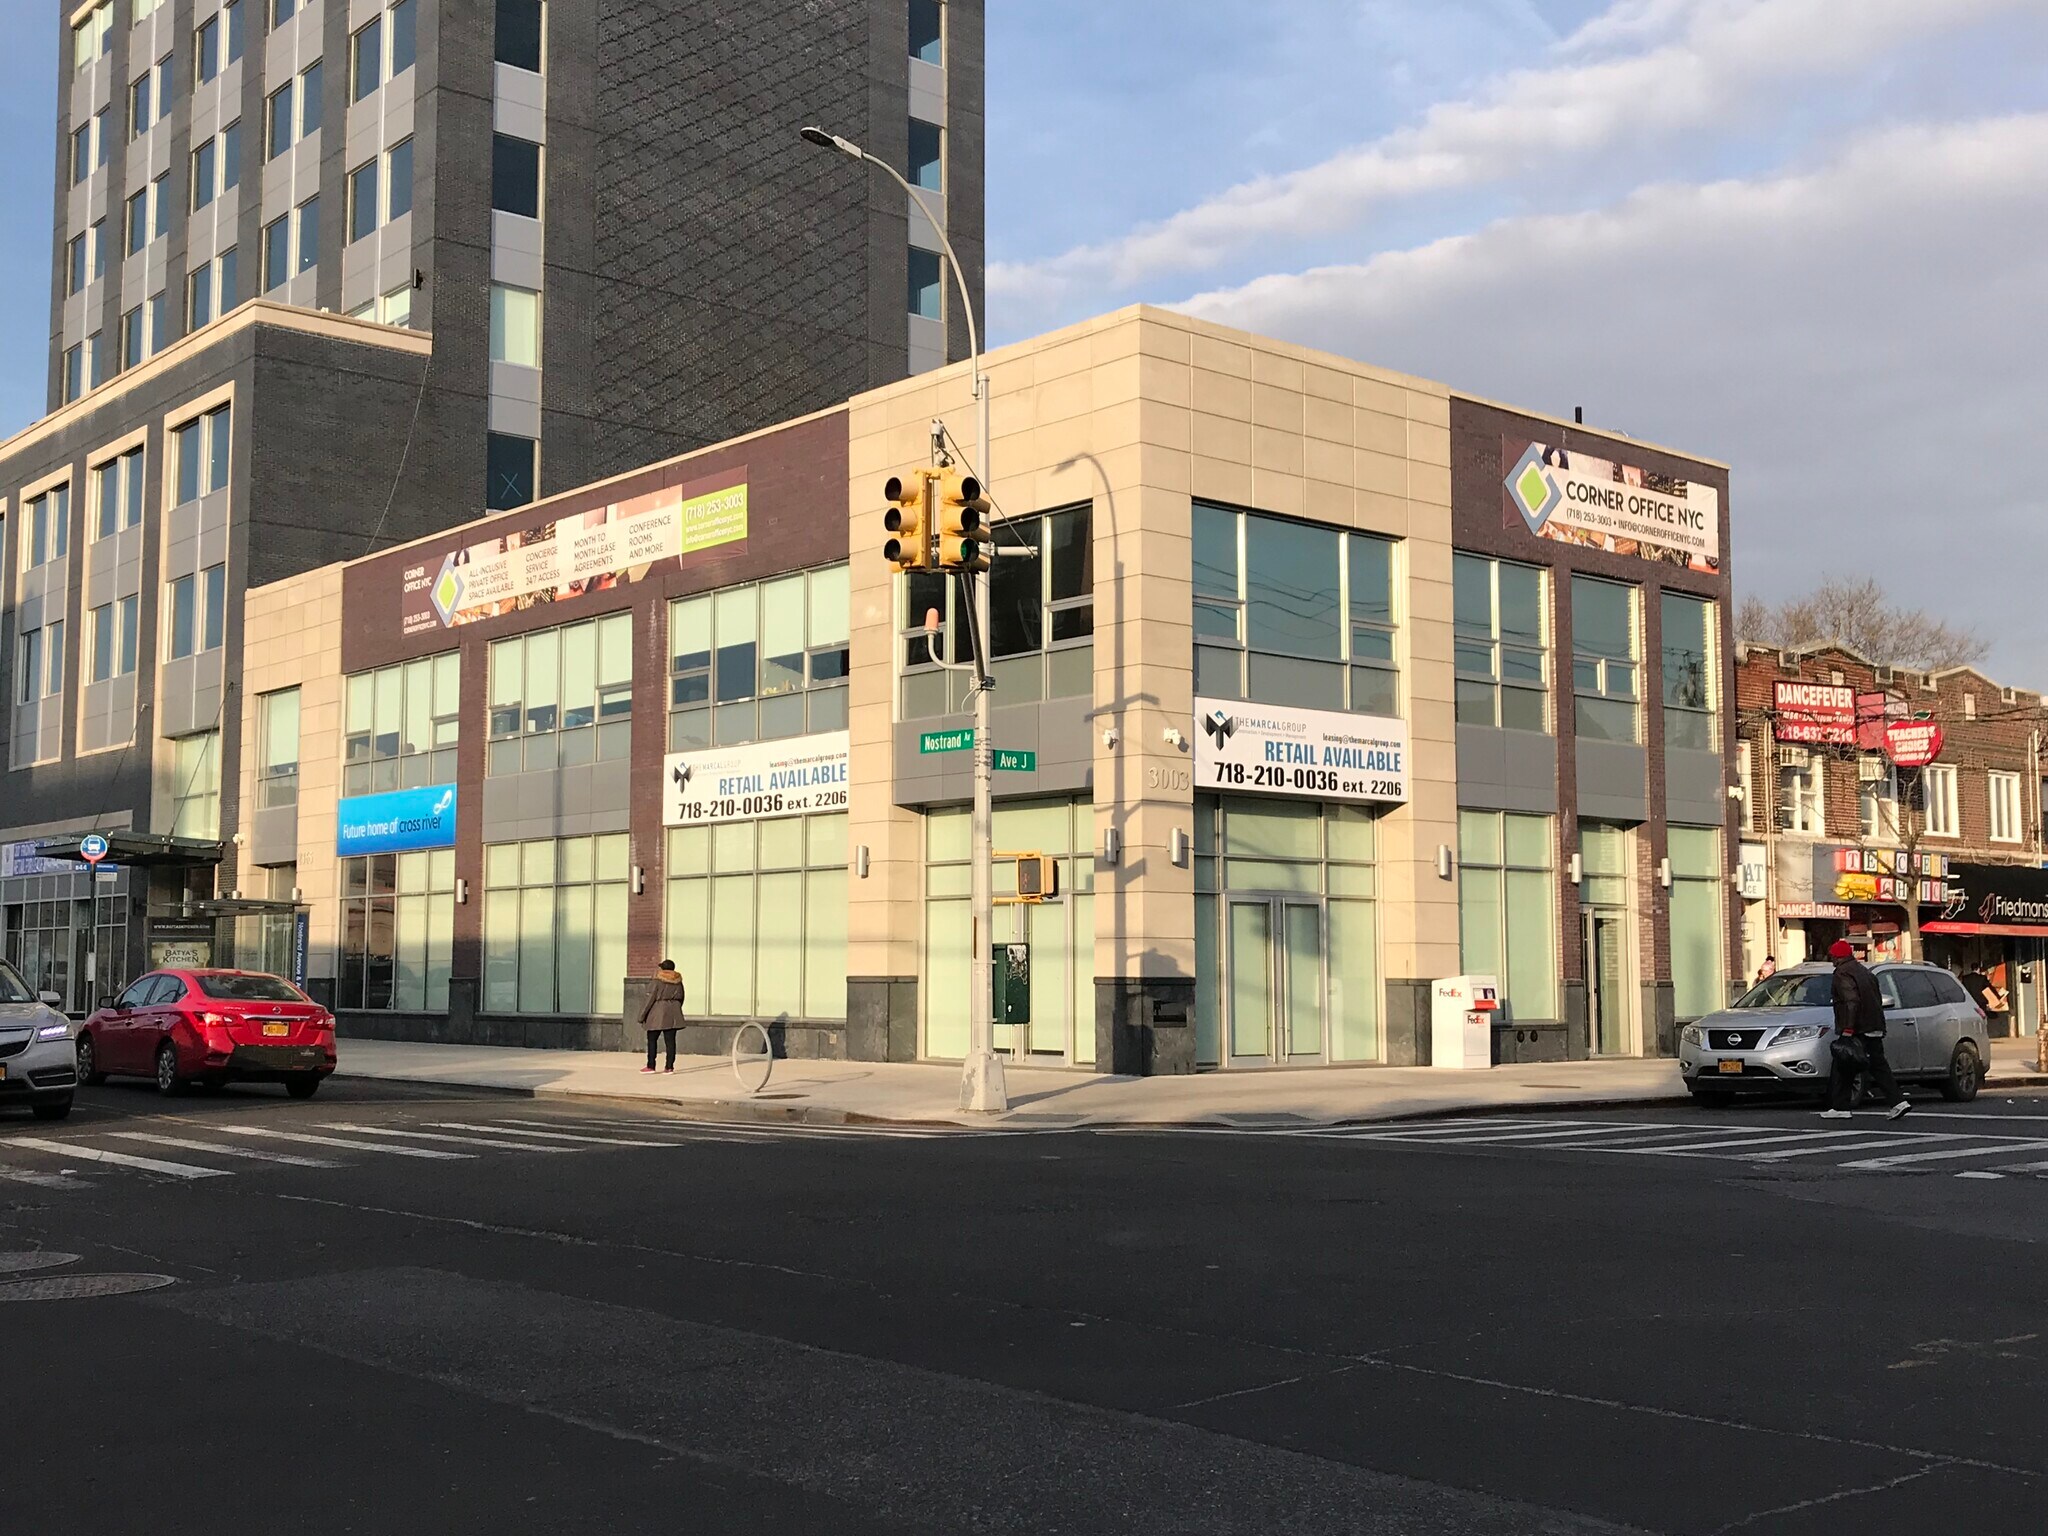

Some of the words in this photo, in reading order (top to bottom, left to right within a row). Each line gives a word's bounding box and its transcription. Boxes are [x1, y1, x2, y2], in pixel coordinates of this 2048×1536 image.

[686, 503, 705, 523] (718)
[707, 492, 744, 515] 253-3003
[1565, 480, 1624, 512] CORNER
[1628, 495, 1674, 523] OFFICE
[1678, 507, 1704, 530] NYC
[628, 515, 672, 535] CONFERENCE
[1566, 508, 1582, 522] (718)
[1583, 511, 1612, 527] 253-3003
[1618, 519, 1705, 548] INFO@CORNEROFFICENYC.COM
[574, 535, 596, 549] MONTH
[597, 532, 606, 542] TO
[628, 533, 653, 547] ROOMS
[525, 546, 559, 562] CONCIERGE
[574, 547, 596, 560] MONTH
[597, 541, 616, 555] LEASE
[628, 548, 644, 560] AND
[645, 542, 664, 555] MORE
[526, 560, 549, 574] SERVICE
[574, 554, 614, 573] AGREEMENTS
[468, 576, 489, 590] PRIVATE
[489, 571, 509, 583] OFFICE
[539, 569, 561, 581] ACCESS
[468, 588, 485, 601] SPACE
[485, 580, 514, 596] AVAILABLE
[1777, 683, 1853, 708] DANCEFEVER
[924, 733, 962, 751] Nostrand
[1322, 733, 1401, 748] leasing@themarcalgroup.com
[769, 752, 848, 768] leasing@themarcalgroup.com
[1000, 752, 1018, 768] Ave
[1021, 753, 1027, 769] J
[1265, 740, 1318, 765] RETAIL
[1323, 746, 1402, 772] AVAILABLE
[719, 773, 764, 796] RETAIL
[770, 763, 847, 790] AVAILABLE
[1148, 766, 1190, 791] 3003
[1214, 761, 1338, 791] 718-210-0036
[1342, 780, 1368, 793] ext.
[1371, 780, 1402, 796] 2206
[678, 793, 783, 820] 718-210-0036
[787, 797, 812, 810] ext.
[815, 790, 847, 807] 2206
[343, 824, 365, 839] Future
[367, 821, 388, 836] home
[389, 817, 398, 834] of
[399, 818, 420, 833] cross
[422, 814, 442, 830] river
[1882, 880, 1947, 902] CHICE
[1779, 904, 1812, 916] DANCE
[1816, 905, 1846, 917] DANCE
[1995, 895, 2048, 918] Friedmans
[1439, 988, 1462, 998] FedEx
[1467, 1015, 1485, 1025] FedEx
